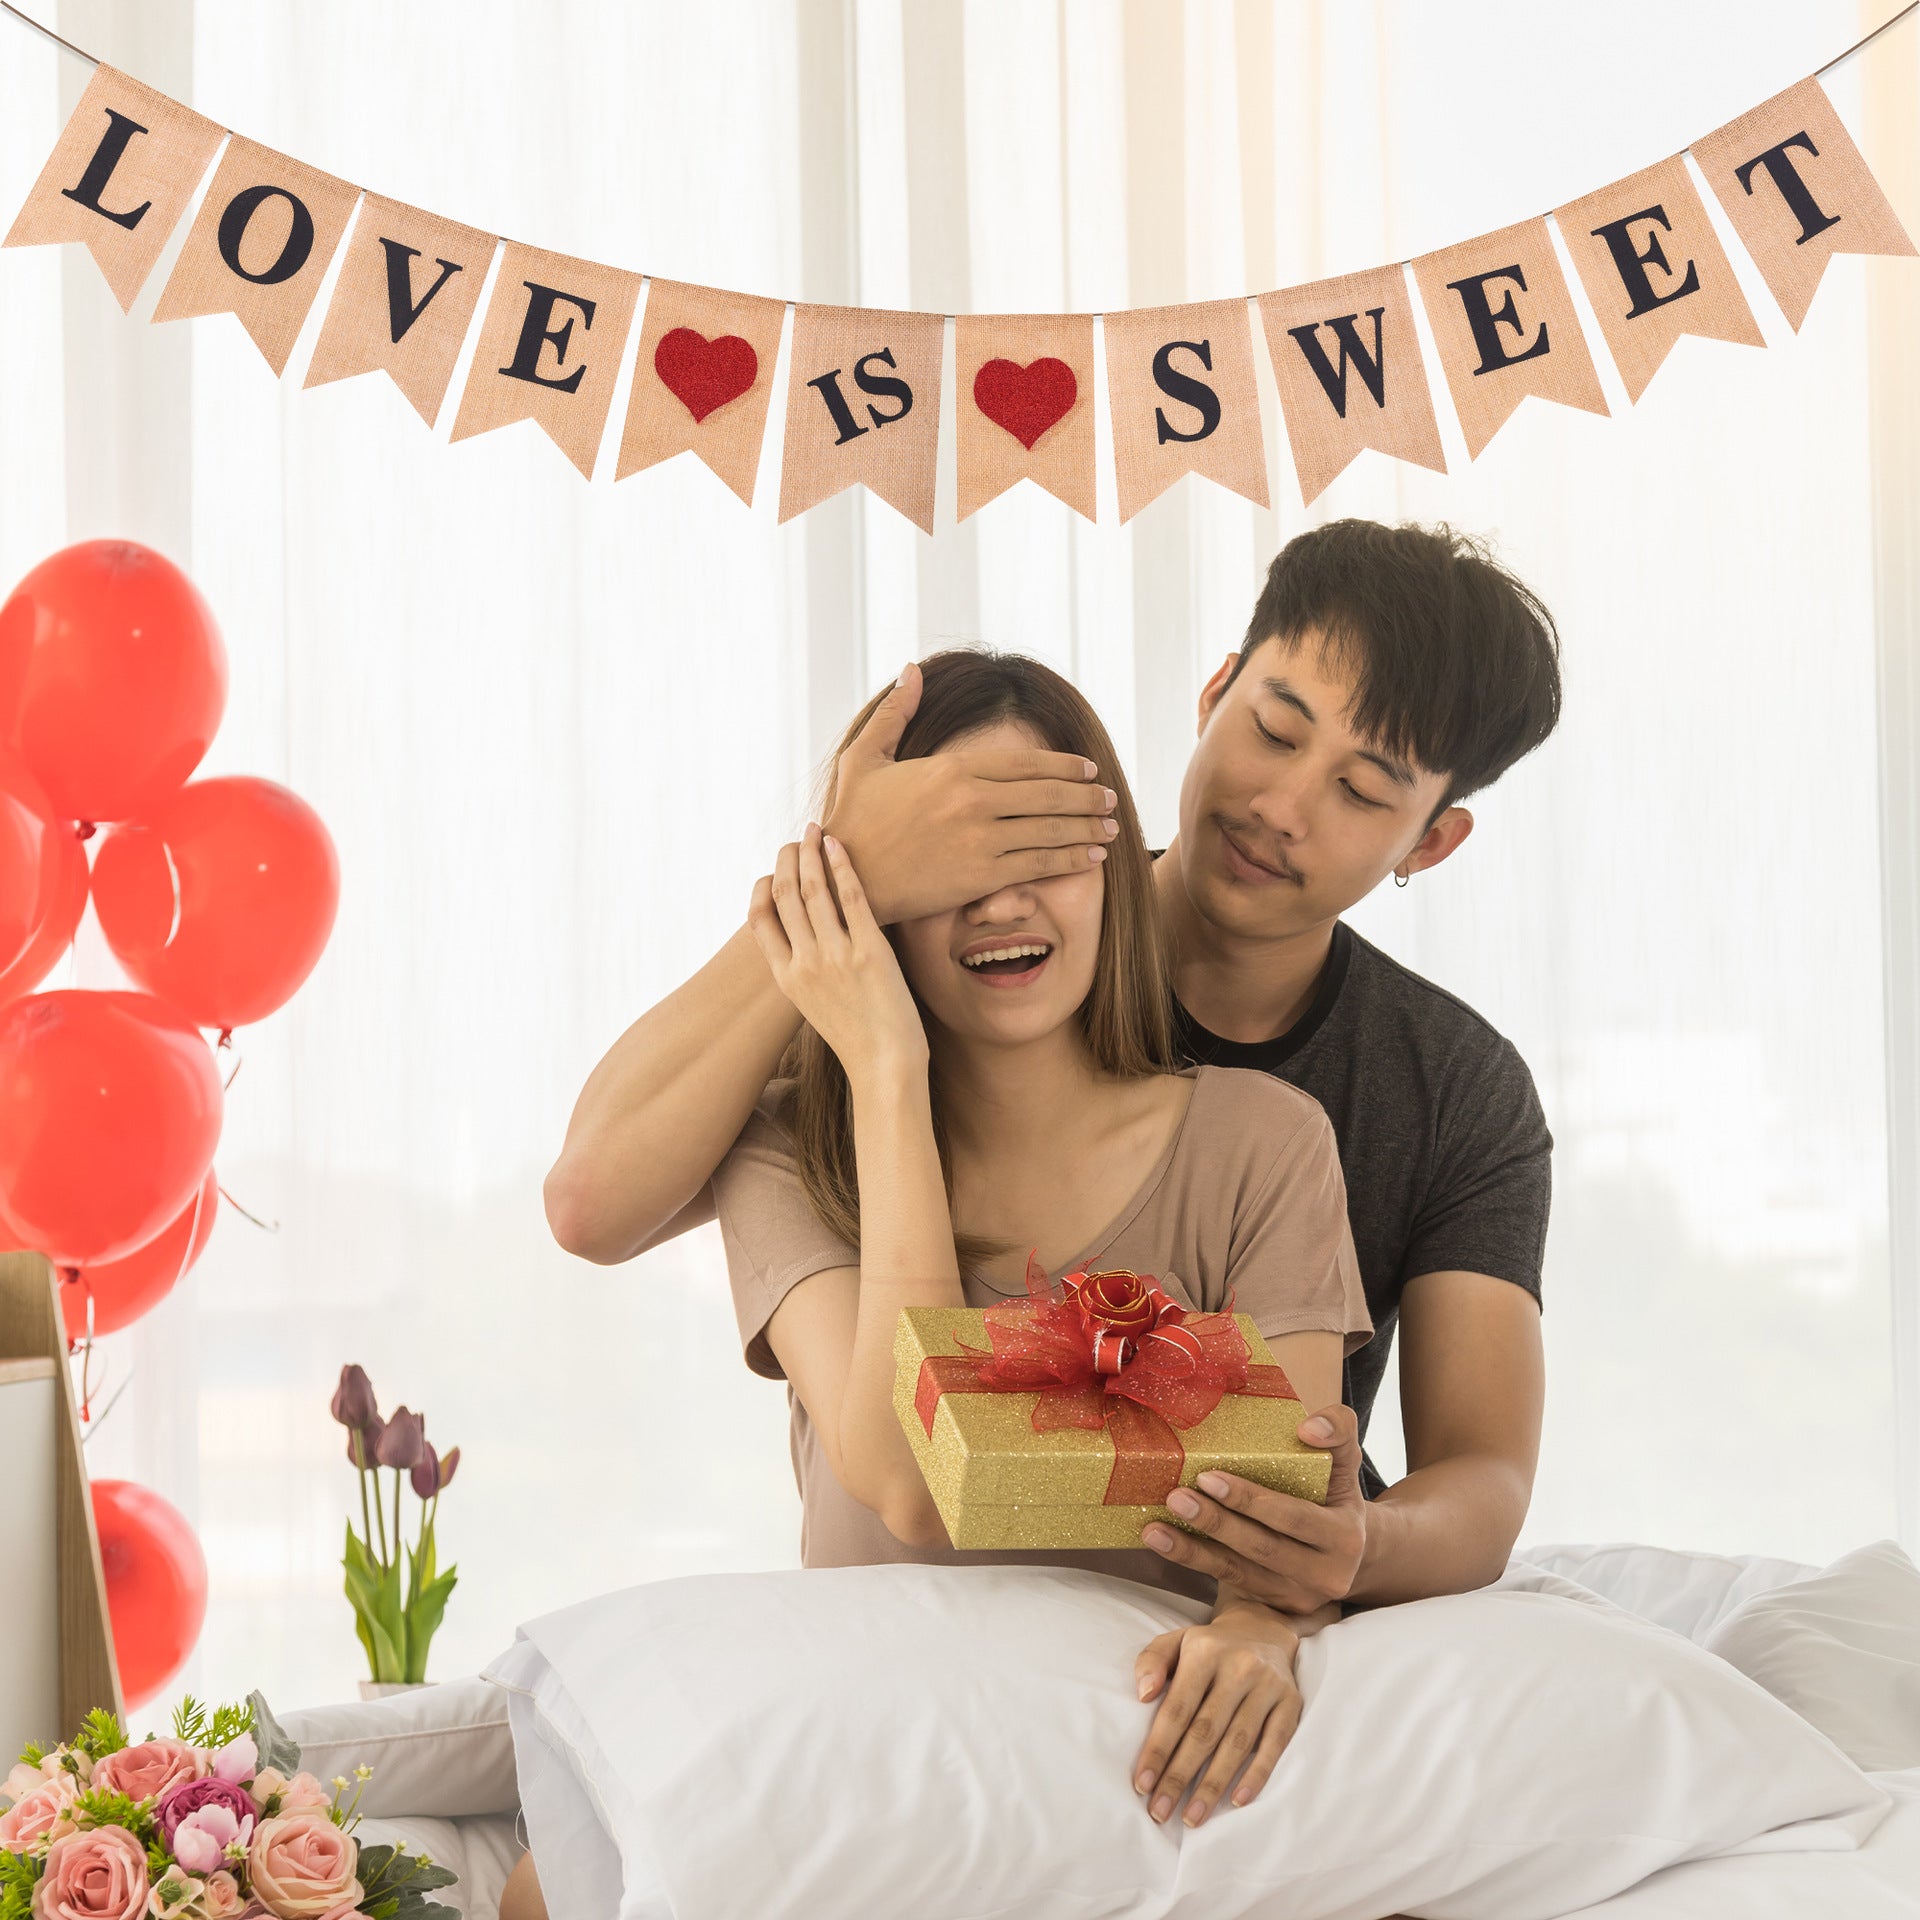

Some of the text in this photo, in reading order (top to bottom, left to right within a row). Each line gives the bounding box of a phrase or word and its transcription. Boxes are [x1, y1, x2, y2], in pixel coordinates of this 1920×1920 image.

[61, 107, 1842, 446] LOVE IS SWEET
